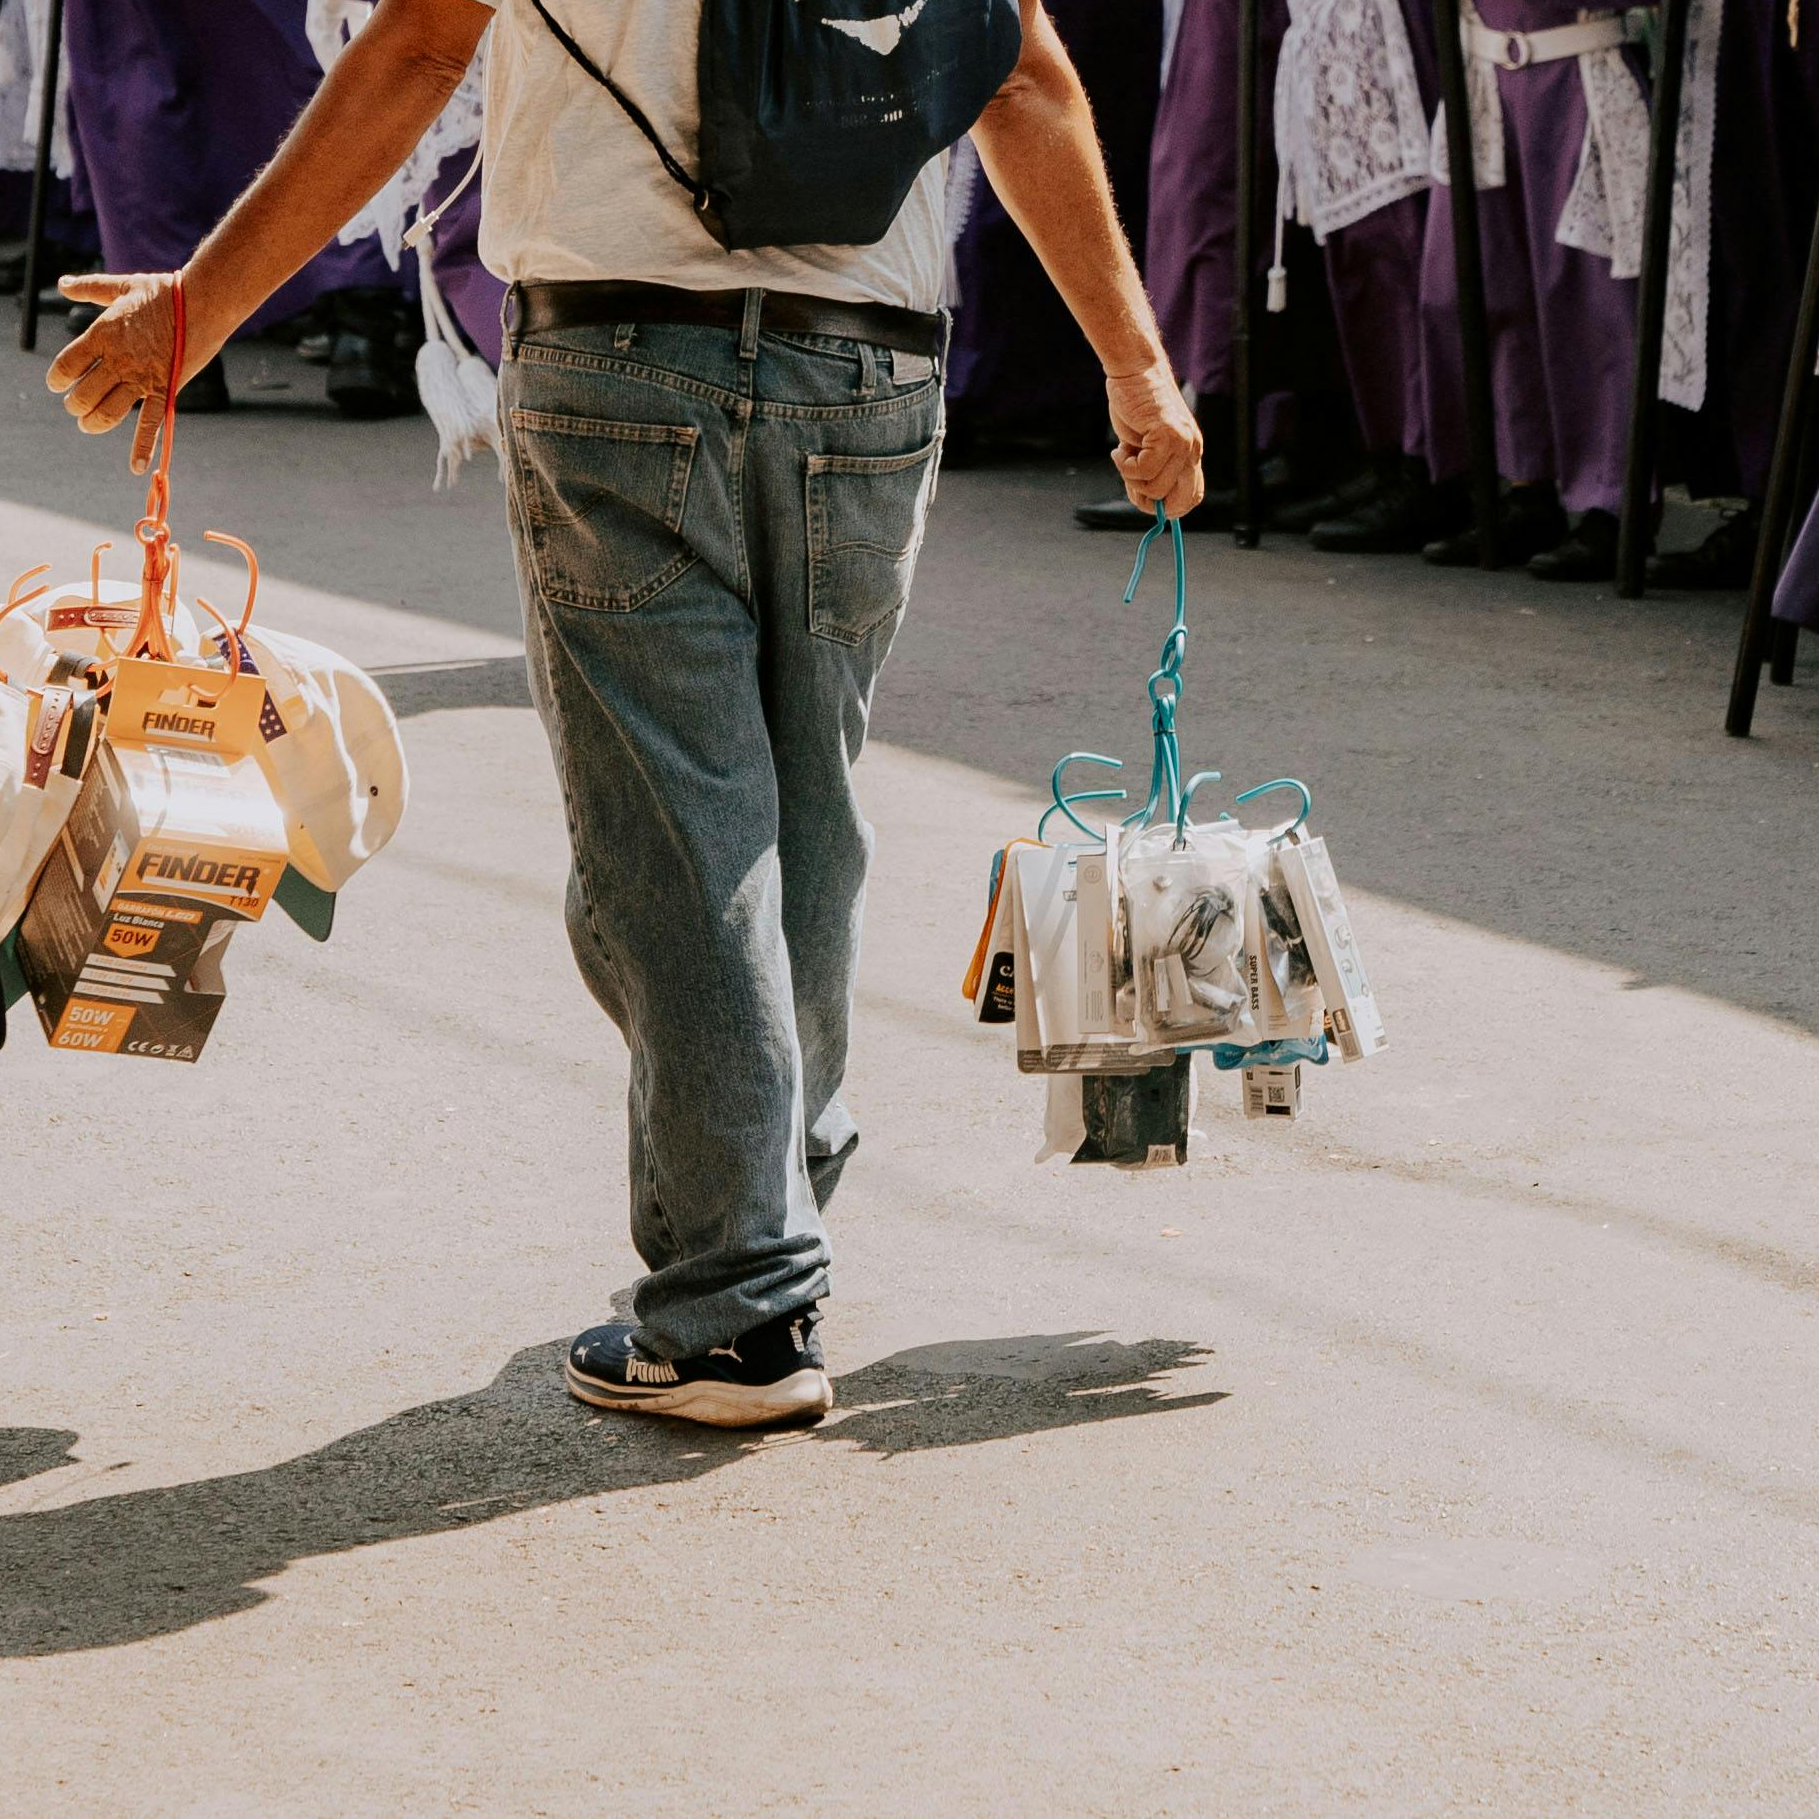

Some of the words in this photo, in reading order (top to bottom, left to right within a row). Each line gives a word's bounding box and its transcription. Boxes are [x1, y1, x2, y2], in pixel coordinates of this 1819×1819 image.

[142, 711, 216, 742] FINDER
[136, 852, 261, 896] FINDER
[113, 912, 133, 923] Luz
[132, 915, 165, 929] Blanca
[111, 929, 154, 947] 50W
[1249, 955, 1259, 985] SUPER
[1251, 987, 1260, 1010] BASS
[68, 1006, 115, 1025] 50W
[57, 1031, 105, 1047] 60W
